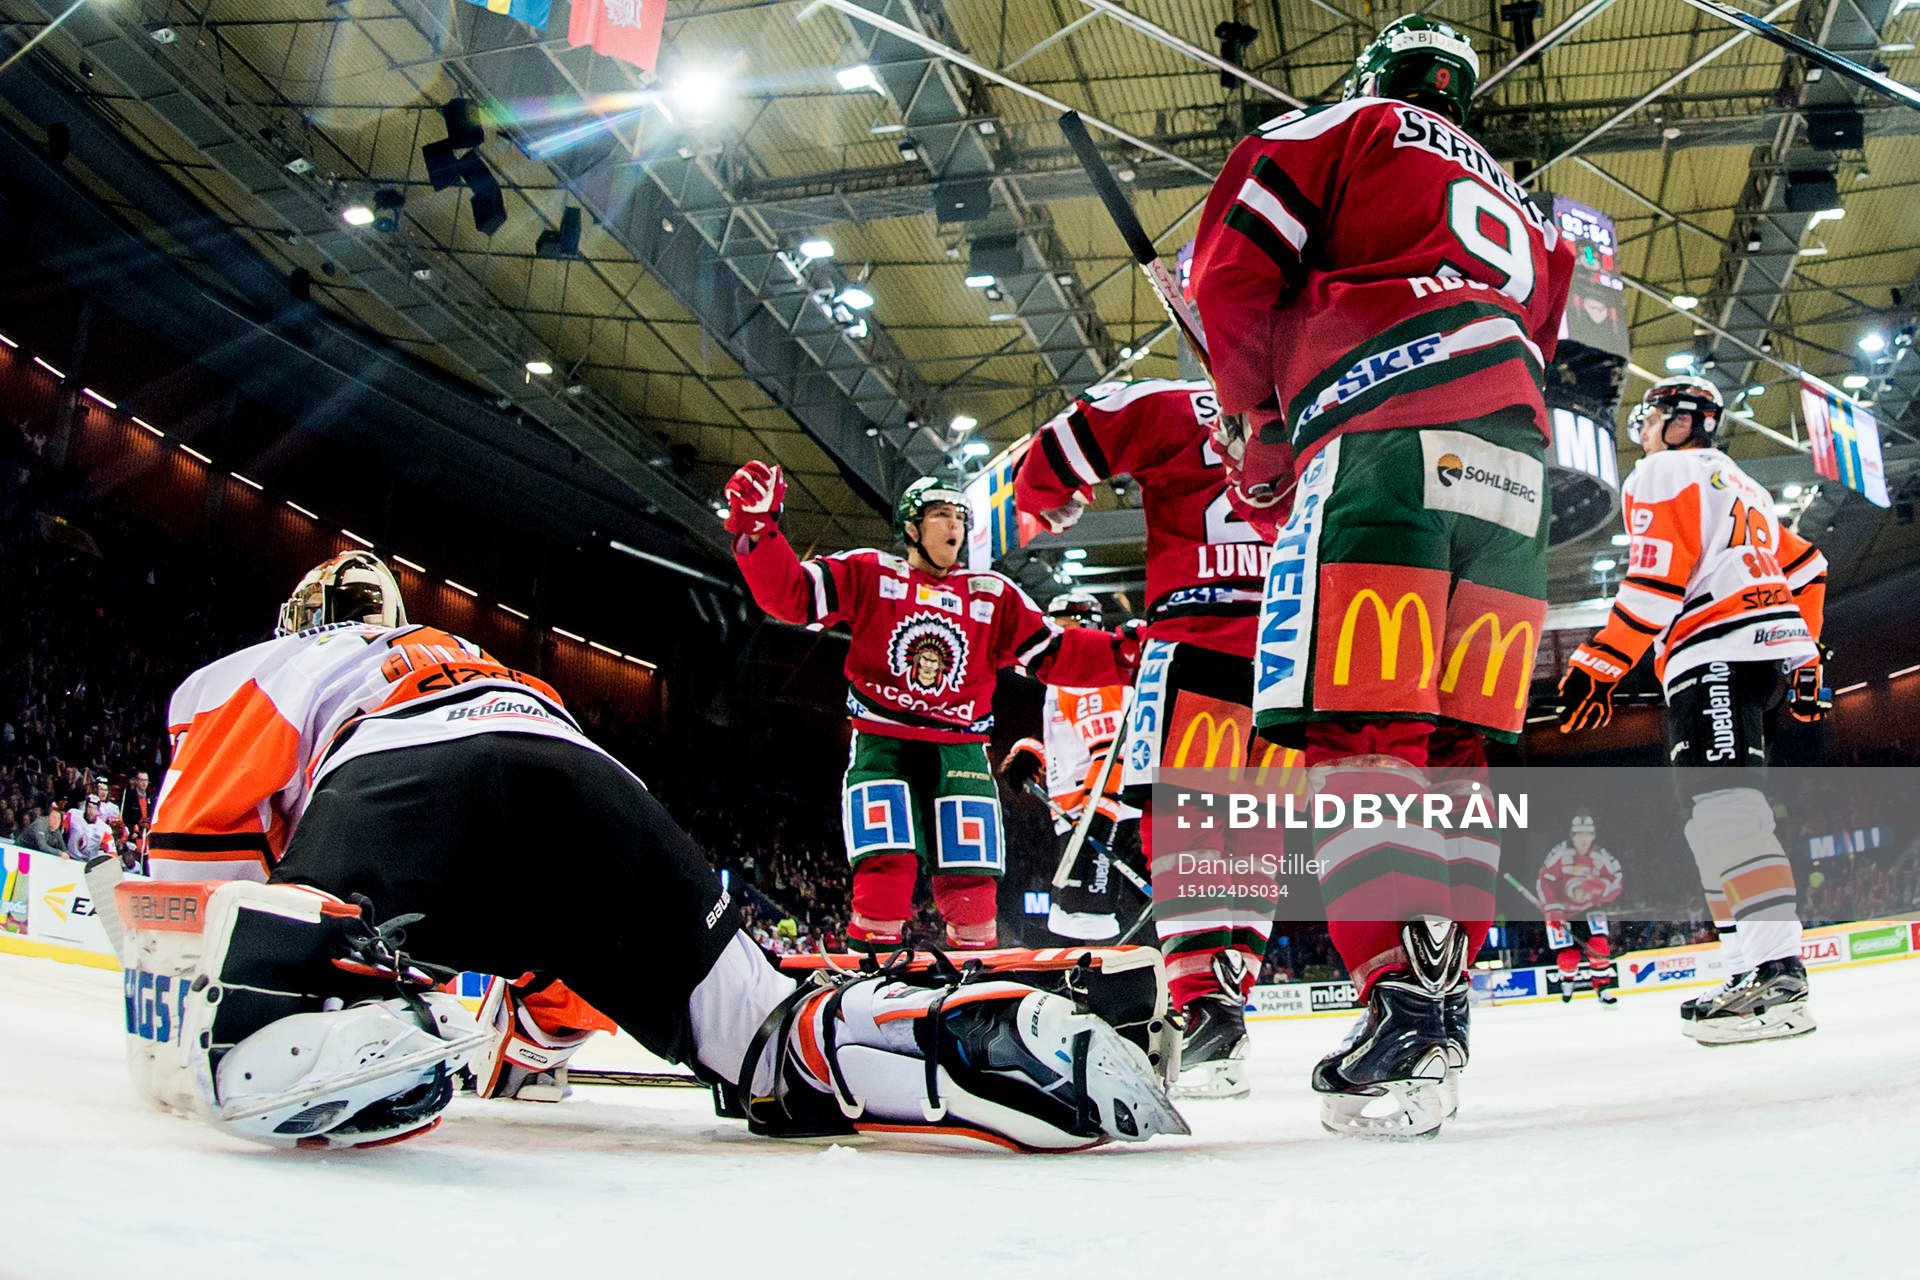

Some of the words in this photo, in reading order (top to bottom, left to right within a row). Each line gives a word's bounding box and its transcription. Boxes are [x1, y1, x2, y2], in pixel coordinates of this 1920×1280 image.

[1435, 67, 1451, 90] 9
[1398, 110, 1548, 225] SERNEK
[1438, 176, 1537, 303] 9
[1337, 336, 1441, 401] SKF
[1464, 466, 1536, 503] SOHLBERG
[1258, 493, 1319, 694] STENA
[446, 701, 560, 723] BERGKVA
[1077, 694, 1103, 720] 29
[1081, 717, 1117, 739] ABB
[1704, 685, 1736, 762] Sweden
[1657, 957, 1695, 970] INTER
[1658, 968, 1697, 981] SPORT
[1261, 990, 1291, 999] FOLIE
[1261, 1001, 1303, 1011] PAPPER
